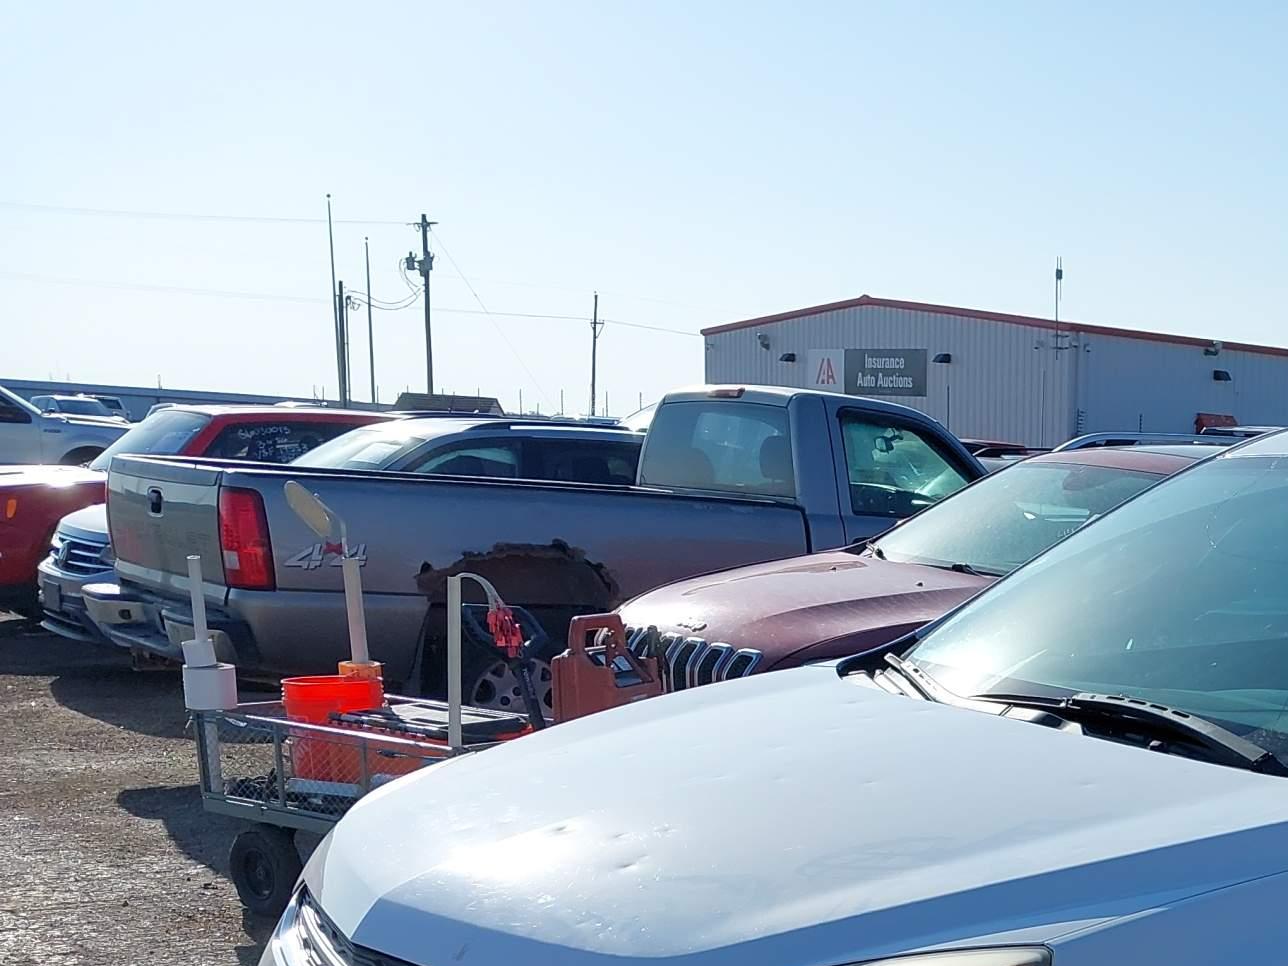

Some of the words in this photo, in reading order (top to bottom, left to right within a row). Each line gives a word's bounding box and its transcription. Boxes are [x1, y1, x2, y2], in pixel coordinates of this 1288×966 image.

[864, 353, 905, 369] Insurance
[856, 372, 876, 387] Auto
[877, 372, 913, 388] Auctions
